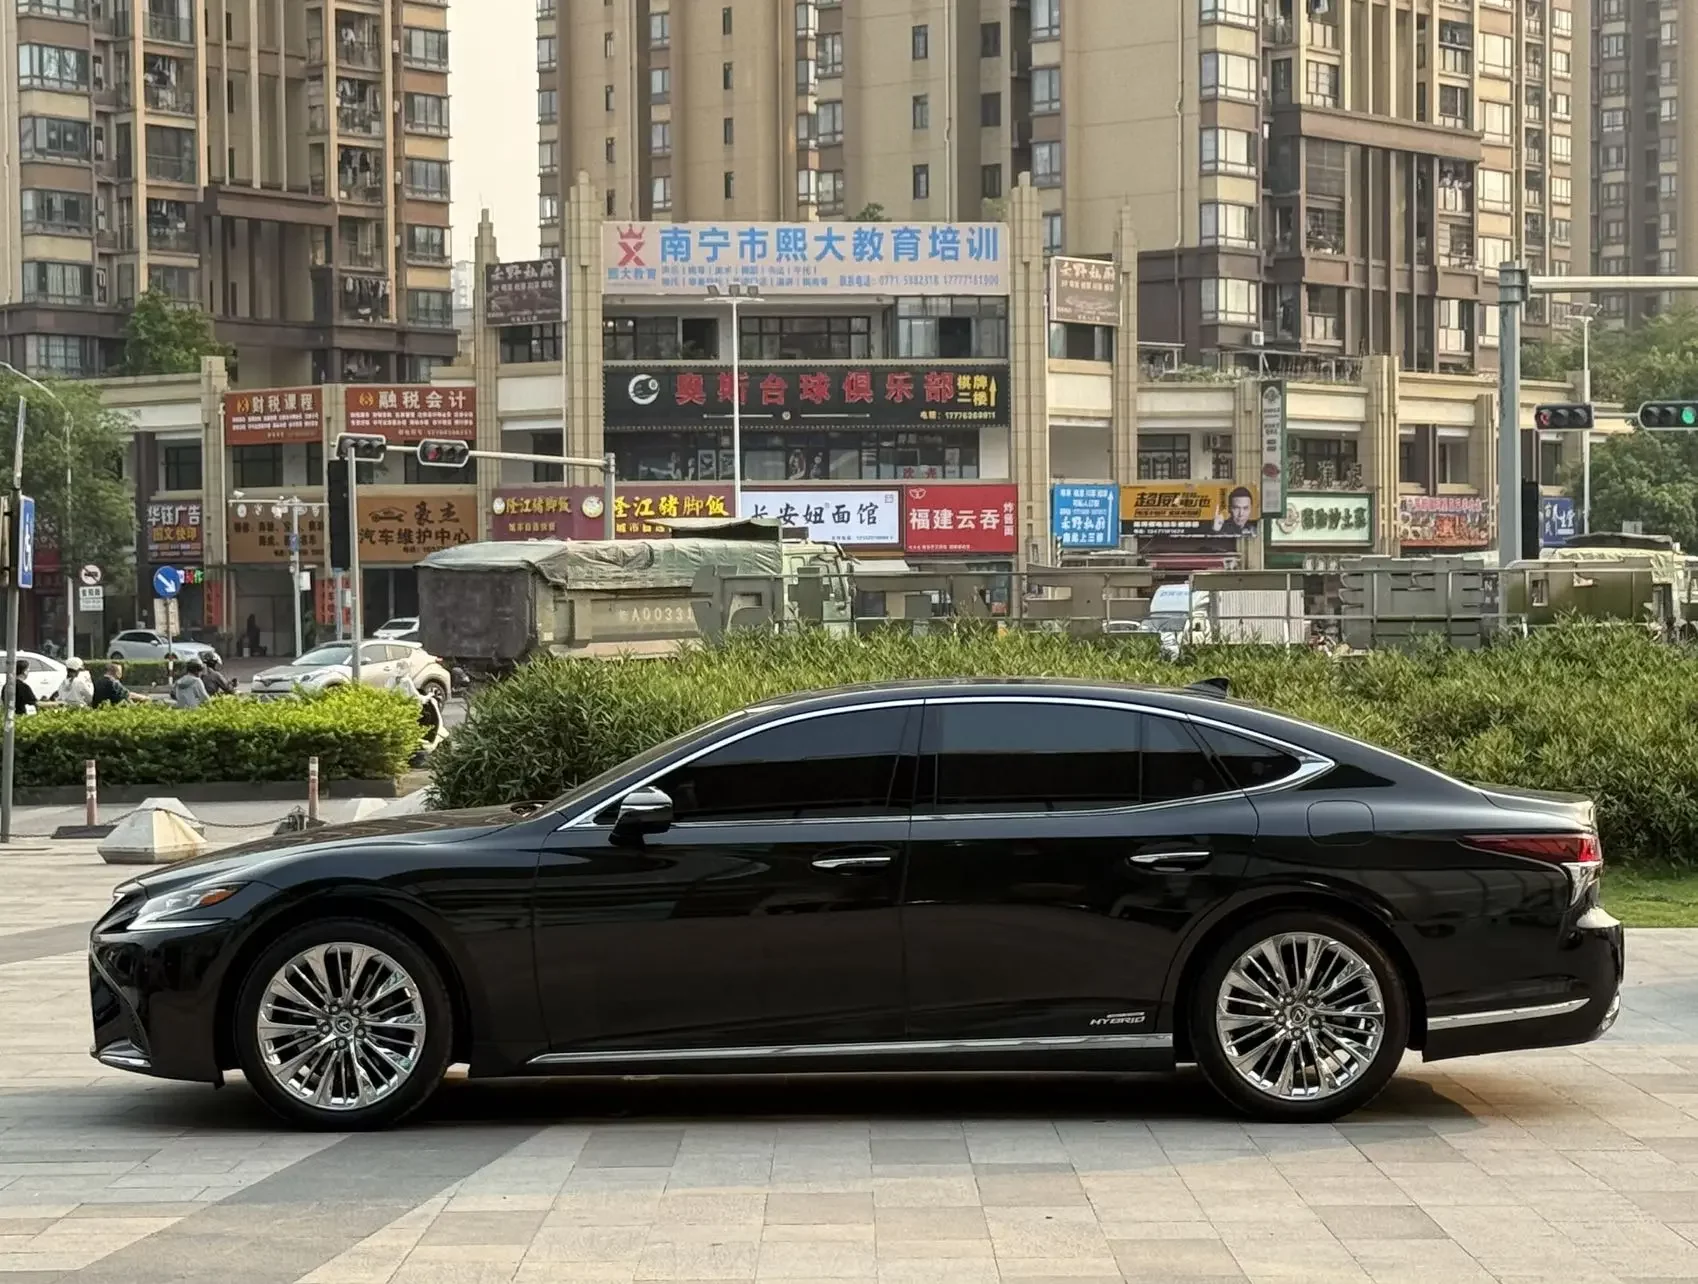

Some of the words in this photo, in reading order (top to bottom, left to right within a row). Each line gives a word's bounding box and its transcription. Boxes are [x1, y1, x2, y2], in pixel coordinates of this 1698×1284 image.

[659, 226, 999, 263] 南宁市熙大教育培训
[674, 370, 955, 405] 奥斯台球俱乐部
[378, 390, 467, 409] 融税会计
[506, 496, 573, 515] 隆江猪脚饭
[751, 502, 880, 526] 长安妞面馆
[909, 508, 1000, 530] 福建云吞
[358, 527, 471, 545] 汽车维护中心
[1088, 1014, 1146, 1025] HYBRID
